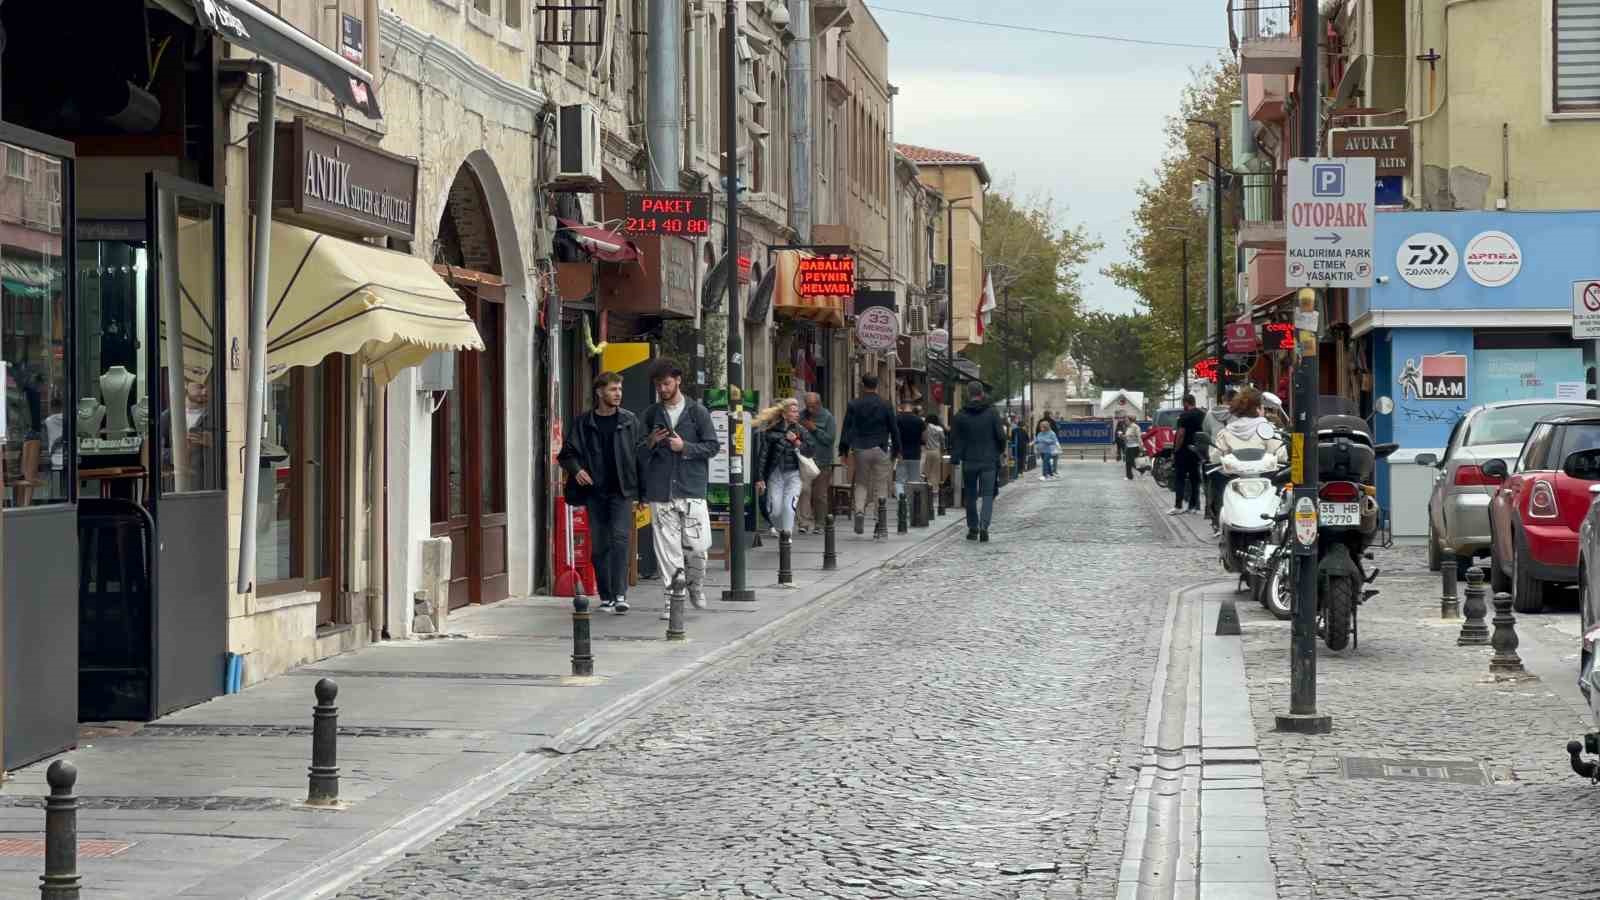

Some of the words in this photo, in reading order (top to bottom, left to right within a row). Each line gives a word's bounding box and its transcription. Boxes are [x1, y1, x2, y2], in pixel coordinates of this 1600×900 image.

[1345, 136, 1396, 151] AVUKAT
[1380, 158, 1406, 168] ALTIN
[304, 144, 351, 208] ANTİK
[642, 199, 692, 213] PAKET
[1292, 203, 1368, 228] OTOPARK
[626, 217, 656, 231] 214
[662, 218, 682, 232] 40
[1289, 249, 1342, 258] KALDIRIMA
[1345, 249, 1371, 258] PARK
[1313, 260, 1346, 269] ETMEK
[868, 313, 890, 324] 33
[1321, 504, 1335, 513] 35
[1343, 504, 1359, 514] HB
